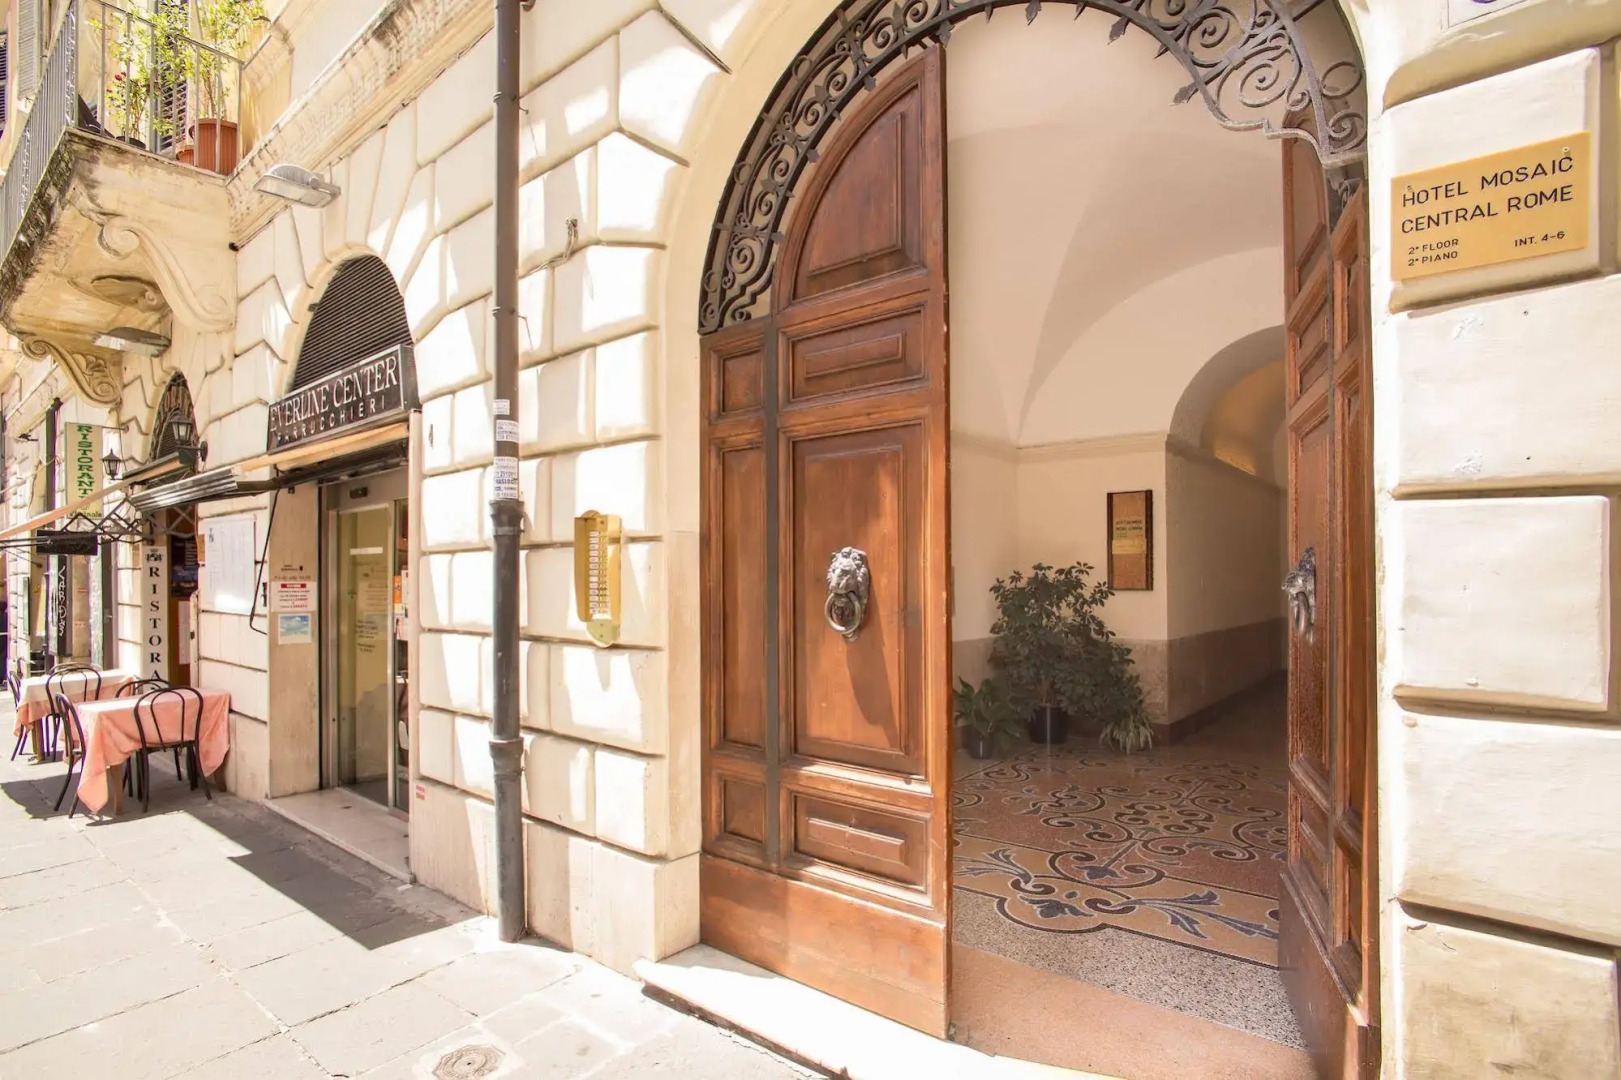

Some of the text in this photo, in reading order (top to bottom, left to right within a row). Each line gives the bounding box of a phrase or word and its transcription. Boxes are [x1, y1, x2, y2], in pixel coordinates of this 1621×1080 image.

[1402, 156, 1574, 208] HOTEL MOSAIC
[1401, 184, 1574, 234] CENTRAL ROME
[1421, 250, 1458, 264] PIANO
[1422, 238, 1459, 252] FLOOR
[1514, 231, 1566, 247] INT. 4-6
[270, 356, 398, 432] EVERLINE CENTER
[76, 425, 95, 499] RISTORANT
[148, 567, 163, 690] RISTORA
